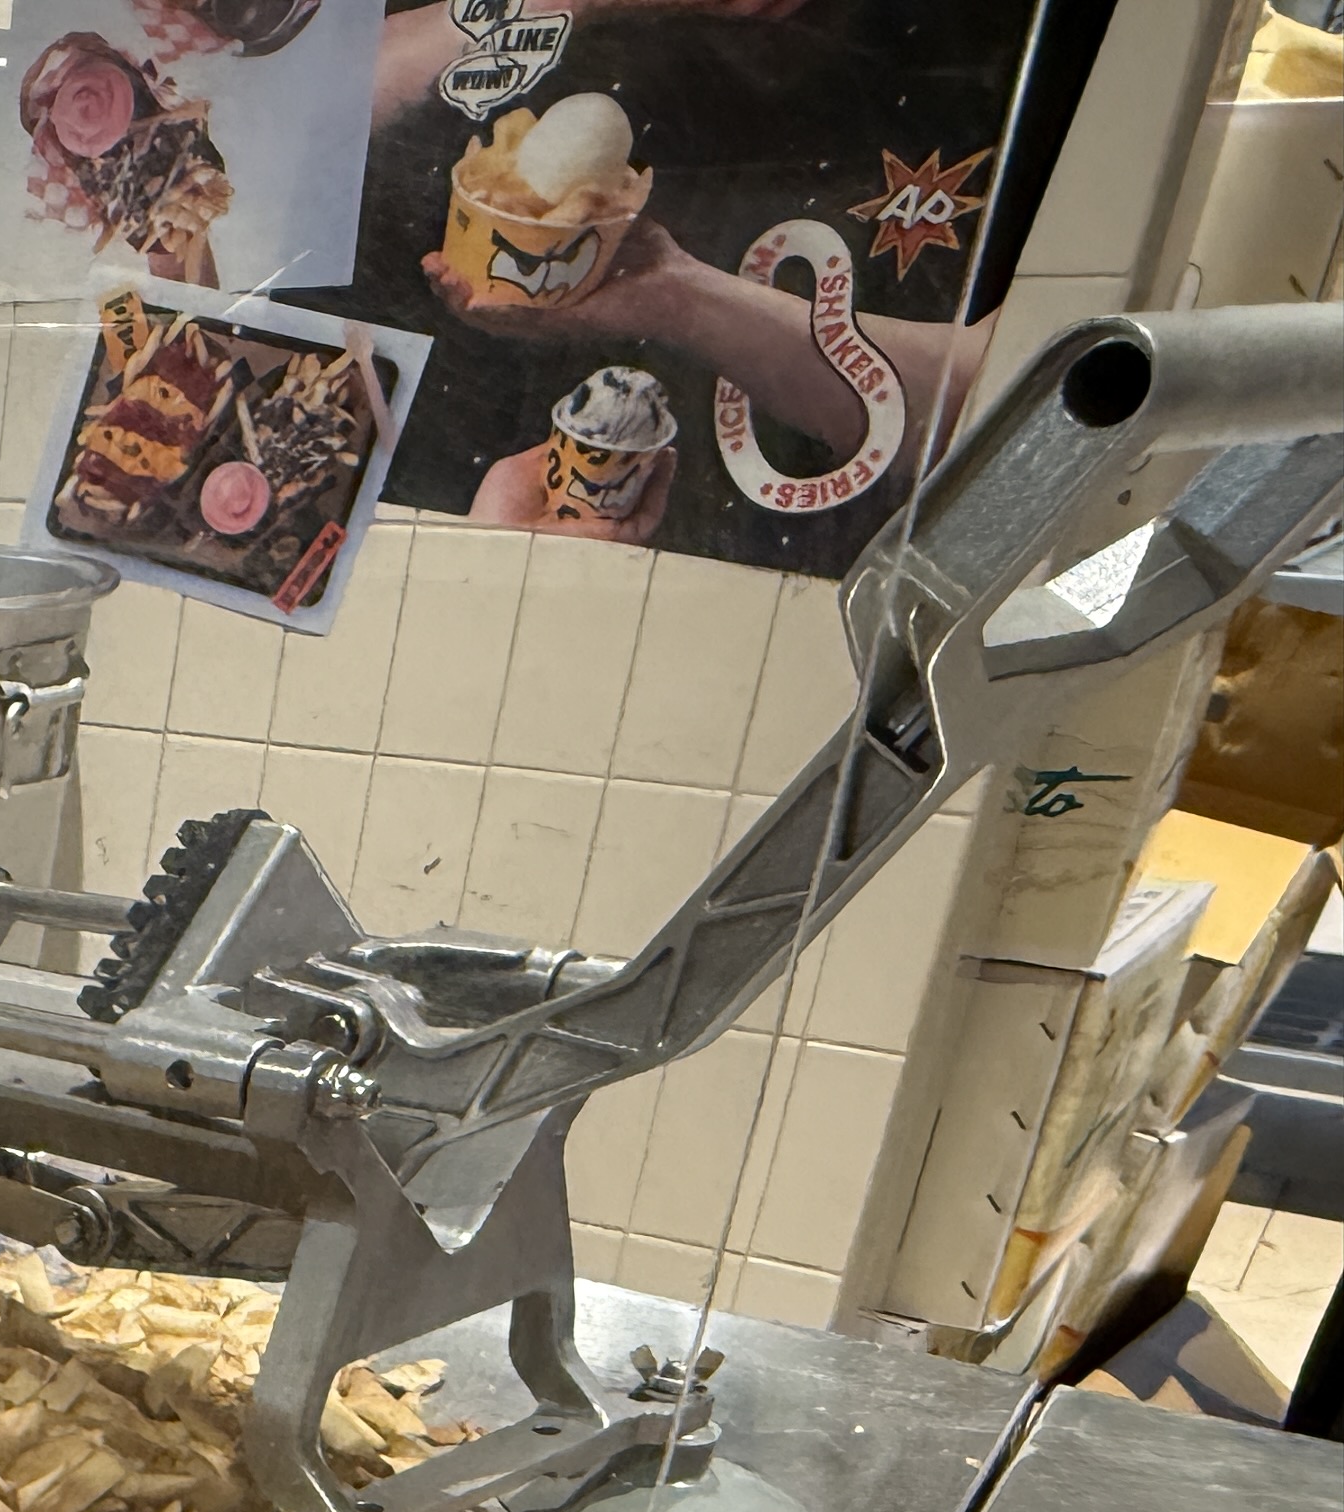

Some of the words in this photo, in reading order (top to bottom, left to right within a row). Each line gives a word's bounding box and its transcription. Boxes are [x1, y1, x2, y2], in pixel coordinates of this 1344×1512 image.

[500, 27, 560, 52] LIKE
[815, 270, 886, 395] SHAKES
[774, 460, 875, 509] FRIES
